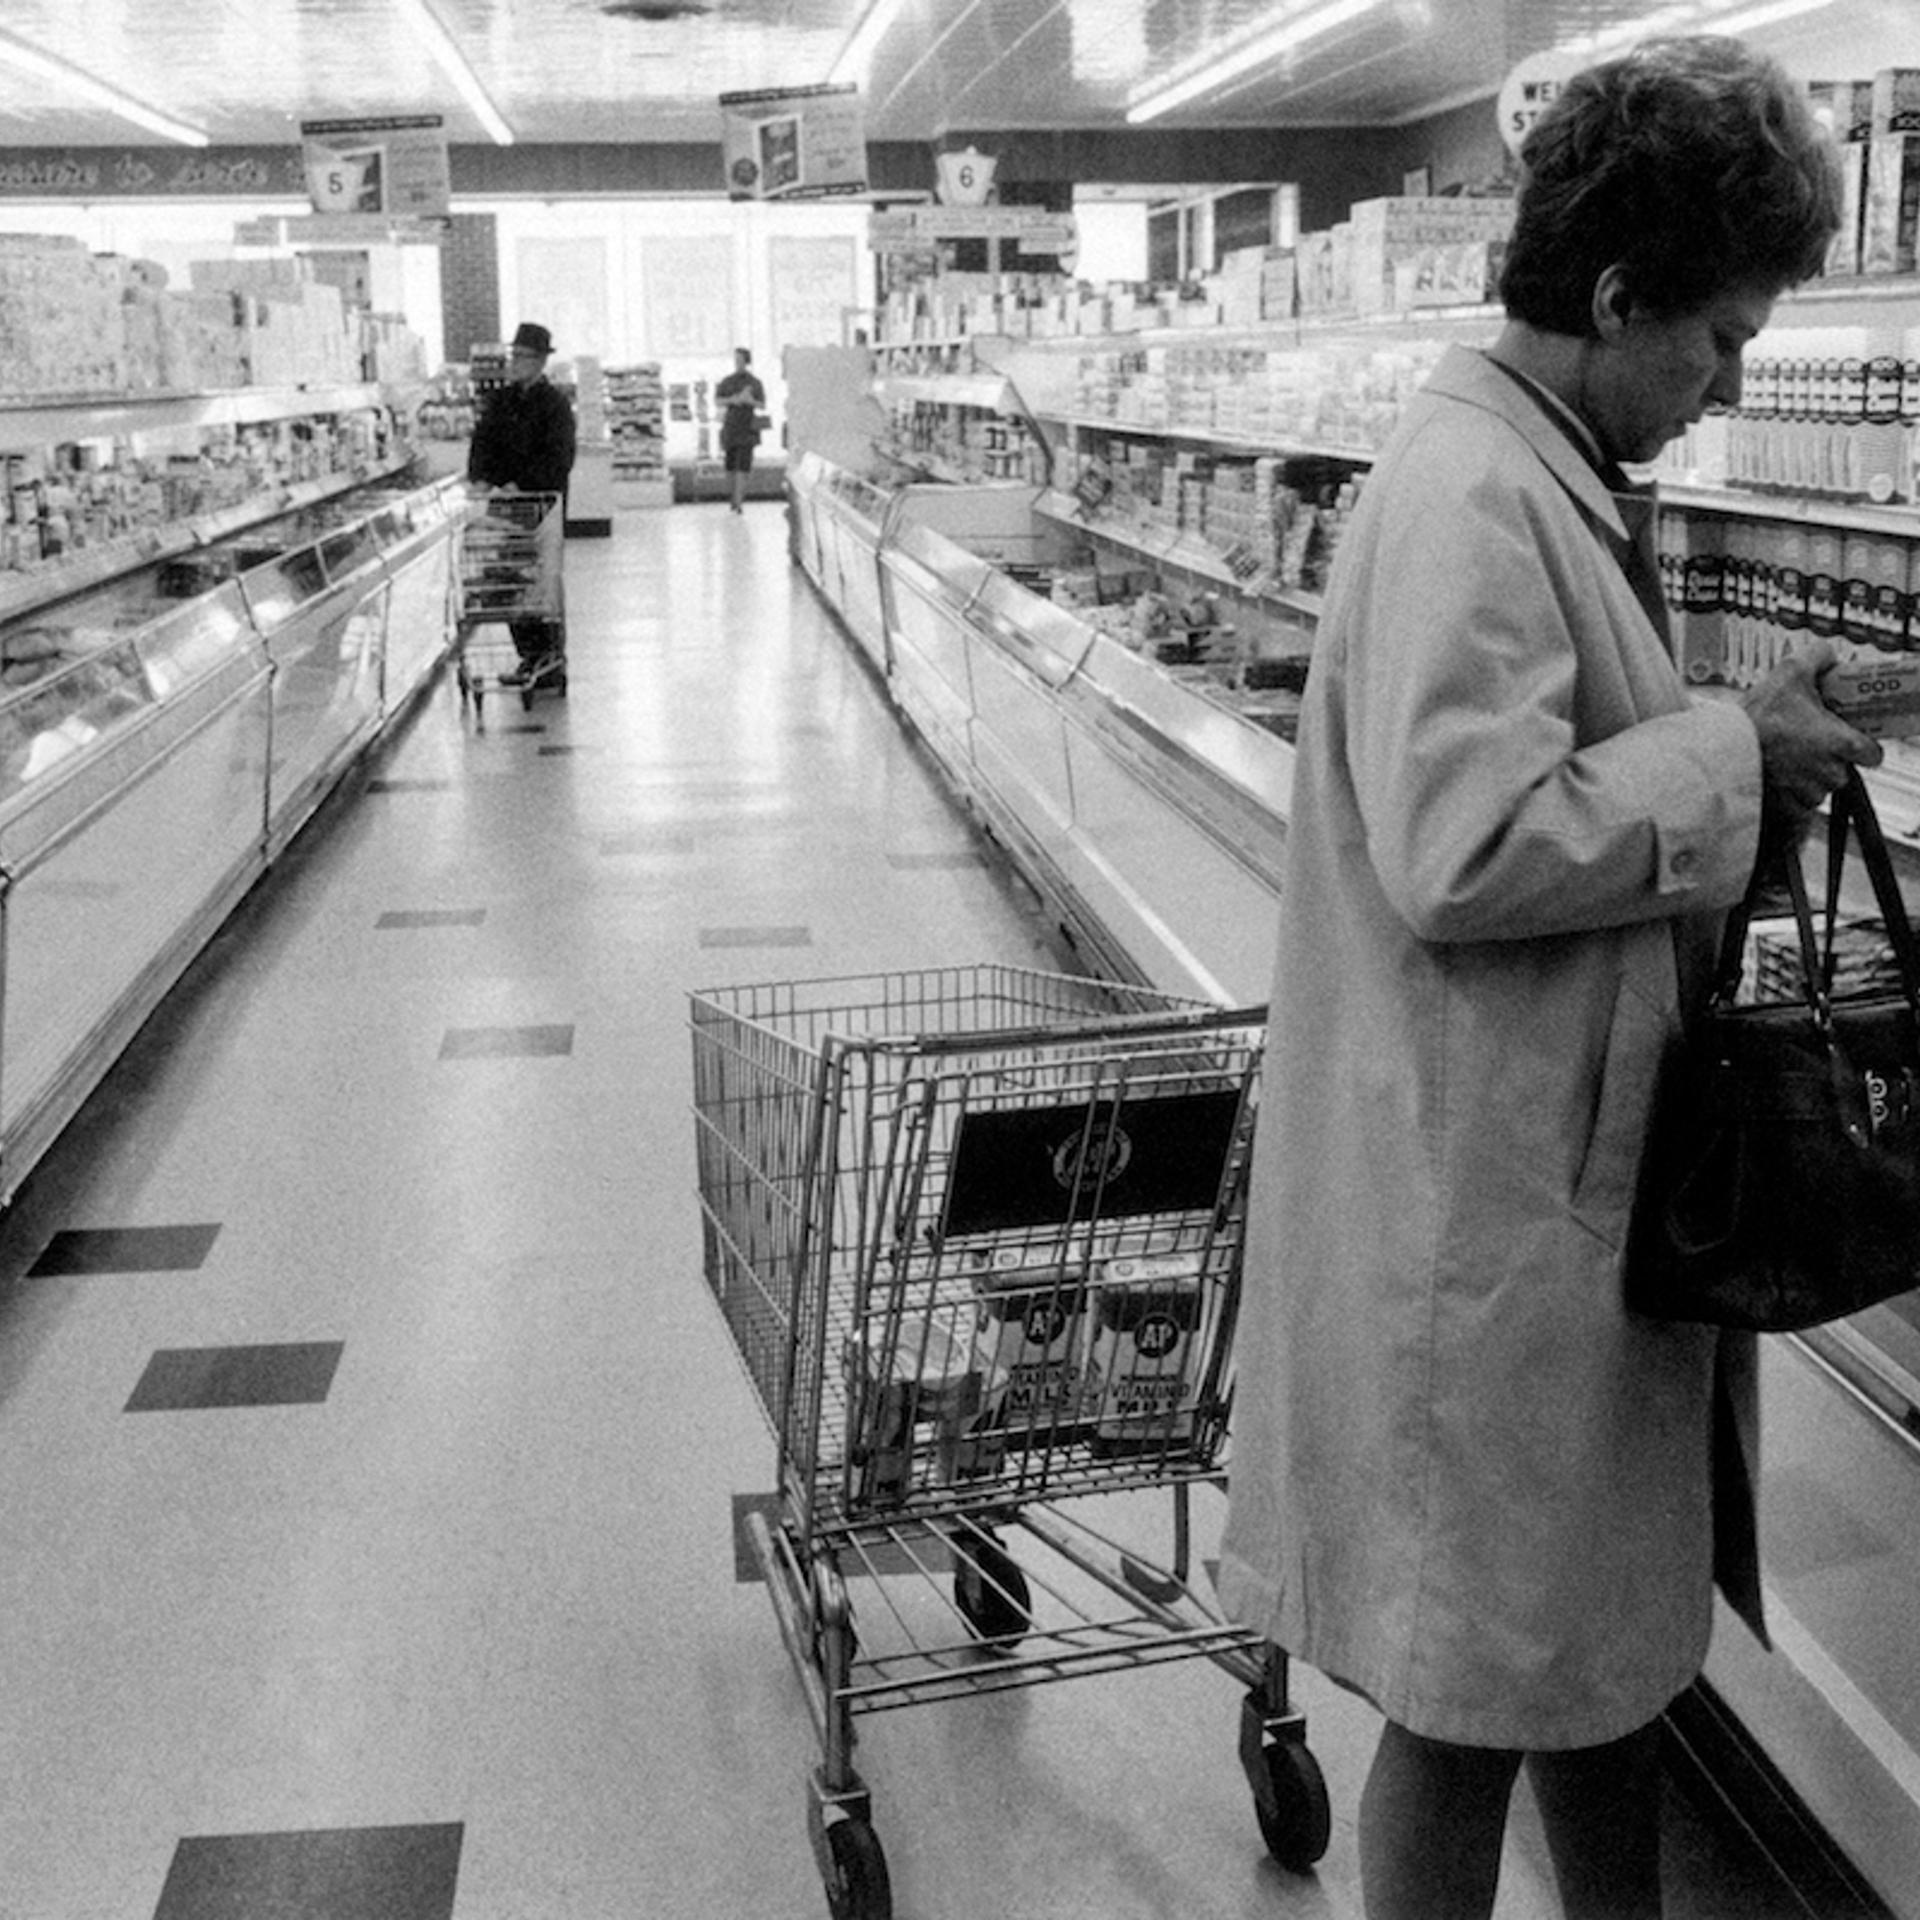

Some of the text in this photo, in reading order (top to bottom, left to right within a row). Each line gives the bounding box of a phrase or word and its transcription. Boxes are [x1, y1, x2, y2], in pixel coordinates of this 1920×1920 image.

[328, 172, 344, 194] 5
[959, 165, 975, 188] 6
[1857, 679, 1901, 695] COD
